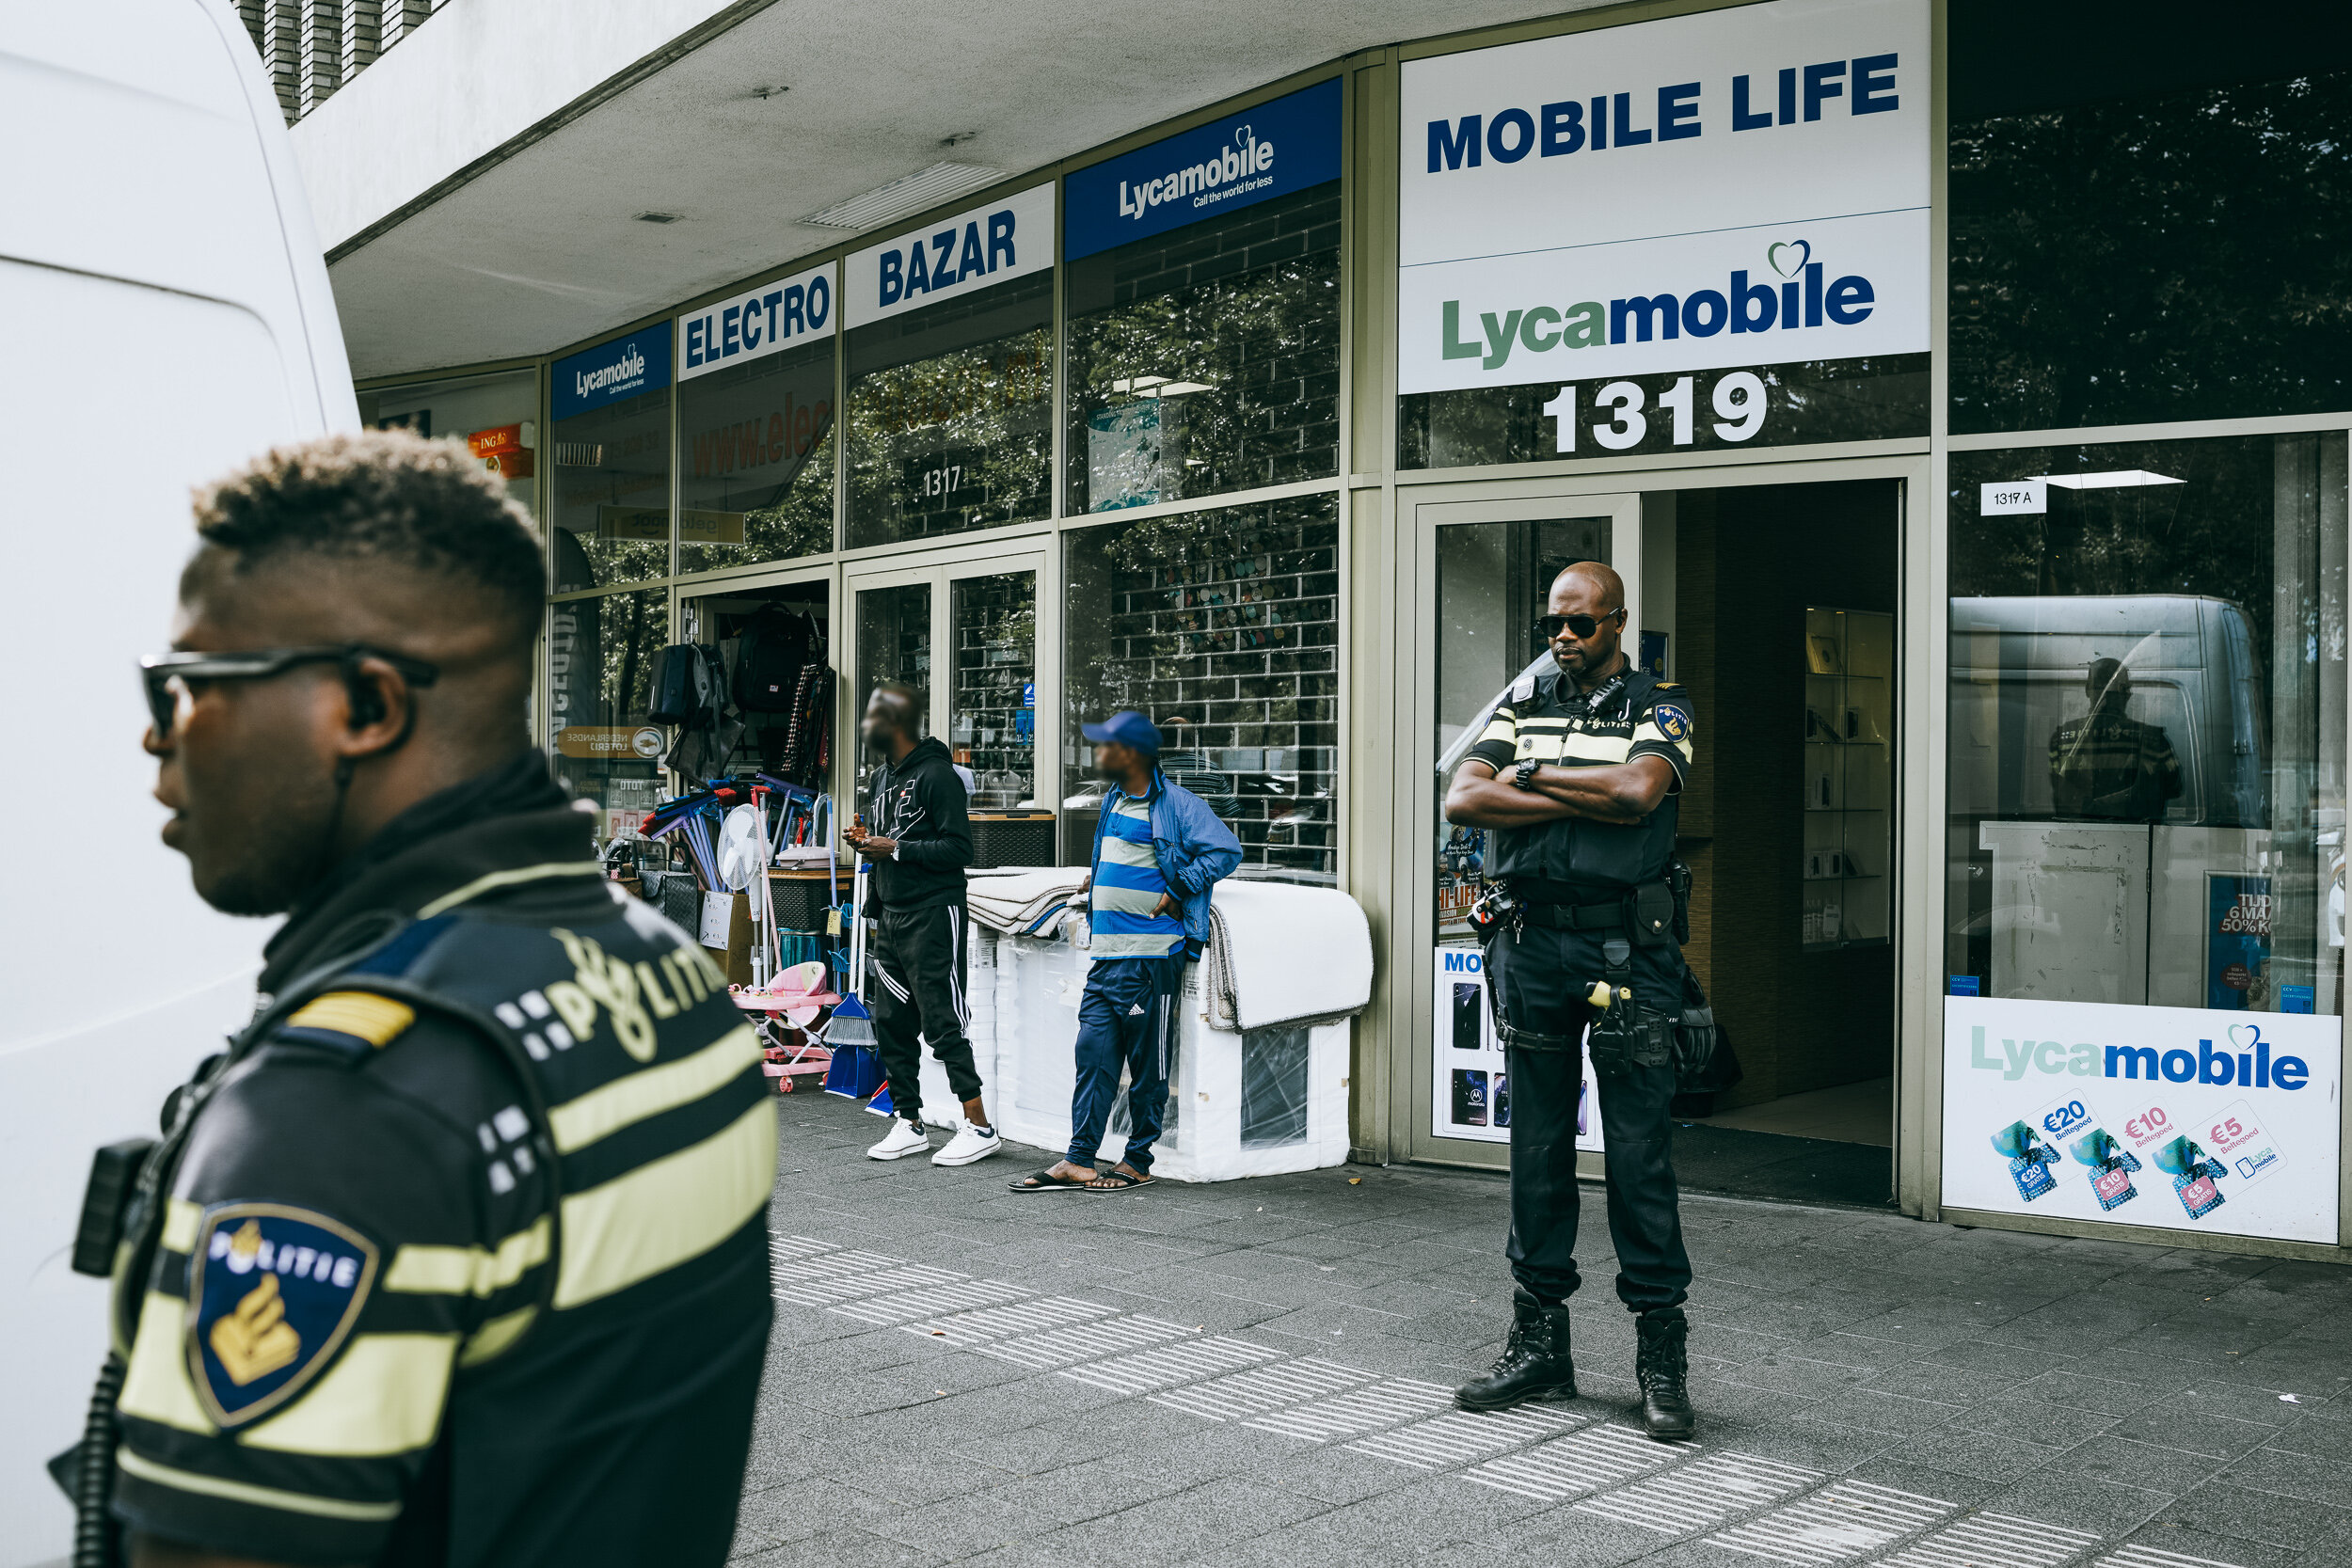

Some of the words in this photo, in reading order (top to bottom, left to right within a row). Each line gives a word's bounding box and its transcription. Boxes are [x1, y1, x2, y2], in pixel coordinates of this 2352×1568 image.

[1426, 81, 1703, 174] MOBILE
[1731, 52, 1899, 133] LIFE
[1119, 132, 1275, 221] Lycamobile
[1193, 195, 1209, 208] Call
[1209, 192, 1222, 204] the
[1222, 183, 1245, 199] world
[1245, 180, 1257, 193] for
[1257, 176, 1273, 190] less
[686, 274, 831, 370] ELECTRO
[879, 208, 1017, 309] BAZAR
[1441, 254, 1877, 371] Lycamobile
[576, 348, 645, 399] Lycamobile
[622, 381, 632, 391] world
[1542, 372, 1769, 453] 1319
[481, 436, 497, 450] ING
[922, 465, 961, 498] 1317
[2023, 491, 2032, 504] A
[1659, 706, 1688, 725] POLITIE
[2221, 918, 2257, 933] 50%
[2258, 920, 2272, 933] K
[2229, 906, 2240, 919] 6
[1971, 1025, 2311, 1091] Lycamobile
[2042, 1100, 2086, 1133] €20
[2055, 1116, 2093, 1142] Beltegoed
[2123, 1106, 2168, 1140] €10
[2135, 1122, 2174, 1148] Beltegoed
[2219, 1127, 2260, 1155] Beltegoed
[2248, 1145, 2273, 1164] Lyca
[2253, 1152, 2277, 1171] mobile
[2020, 1164, 2042, 1183] €20
[2026, 1172, 2046, 1190] GRATIS
[2099, 1172, 2121, 1191] €10
[2106, 1180, 2126, 1197] GRATIS
[2186, 1182, 2203, 1200] €5
[2193, 1188, 2214, 1207] GRATIS
[208, 1225, 359, 1290] POLITIE
